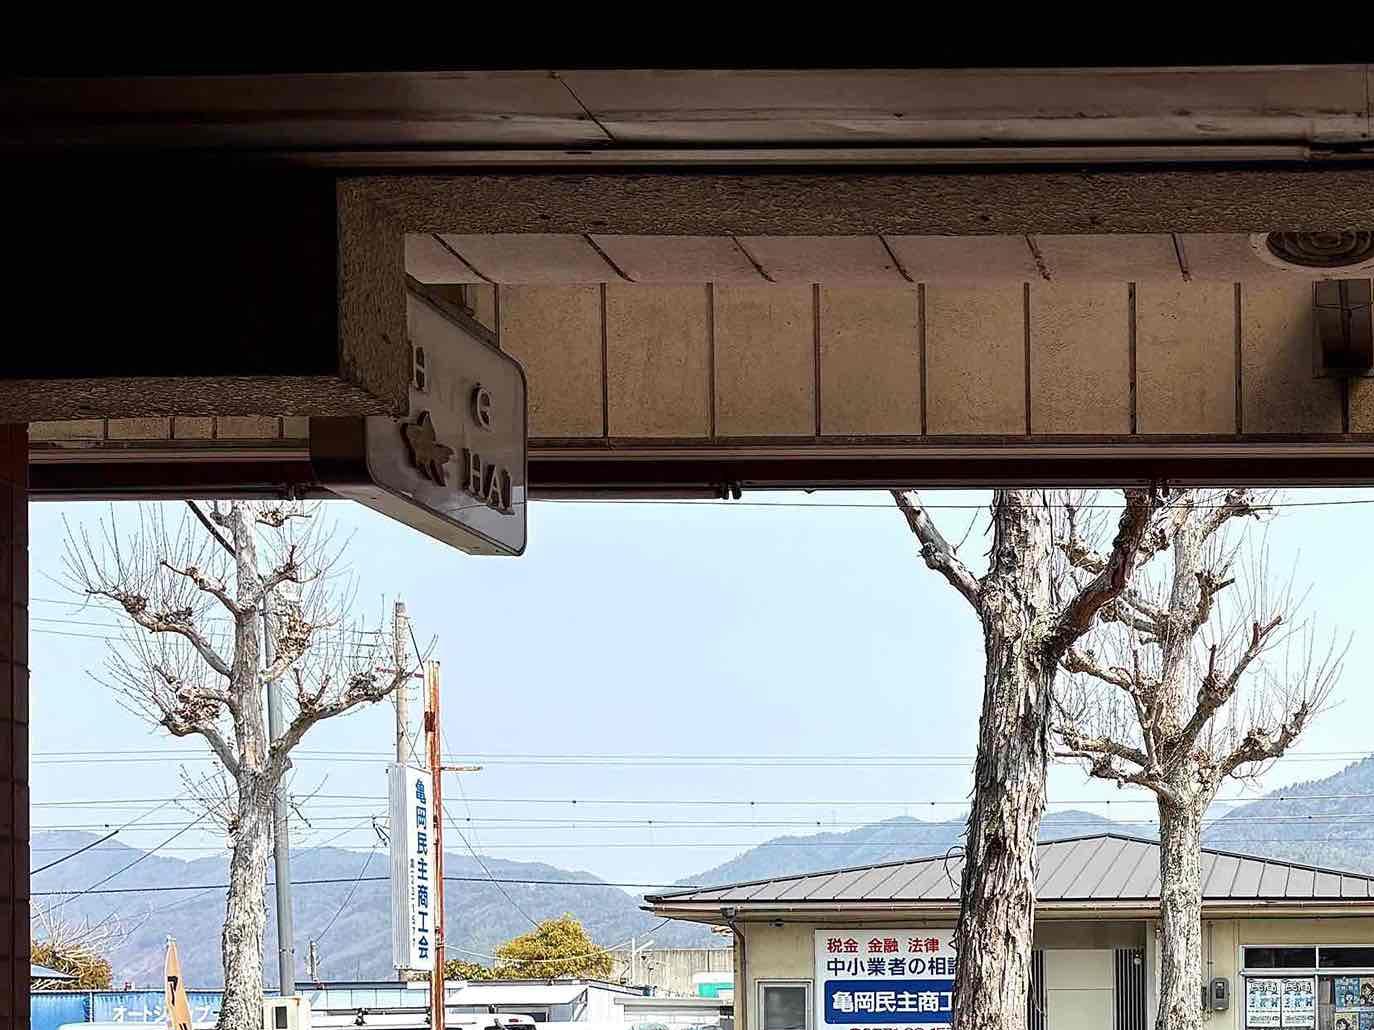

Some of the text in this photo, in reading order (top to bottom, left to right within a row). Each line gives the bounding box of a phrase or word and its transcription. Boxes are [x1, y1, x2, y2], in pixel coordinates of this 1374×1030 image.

[414, 778, 429, 960] 亀岡民主商工会
[827, 938, 859, 953] 税金
[868, 938, 899, 953] 金融
[908, 938, 940, 953] 法律
